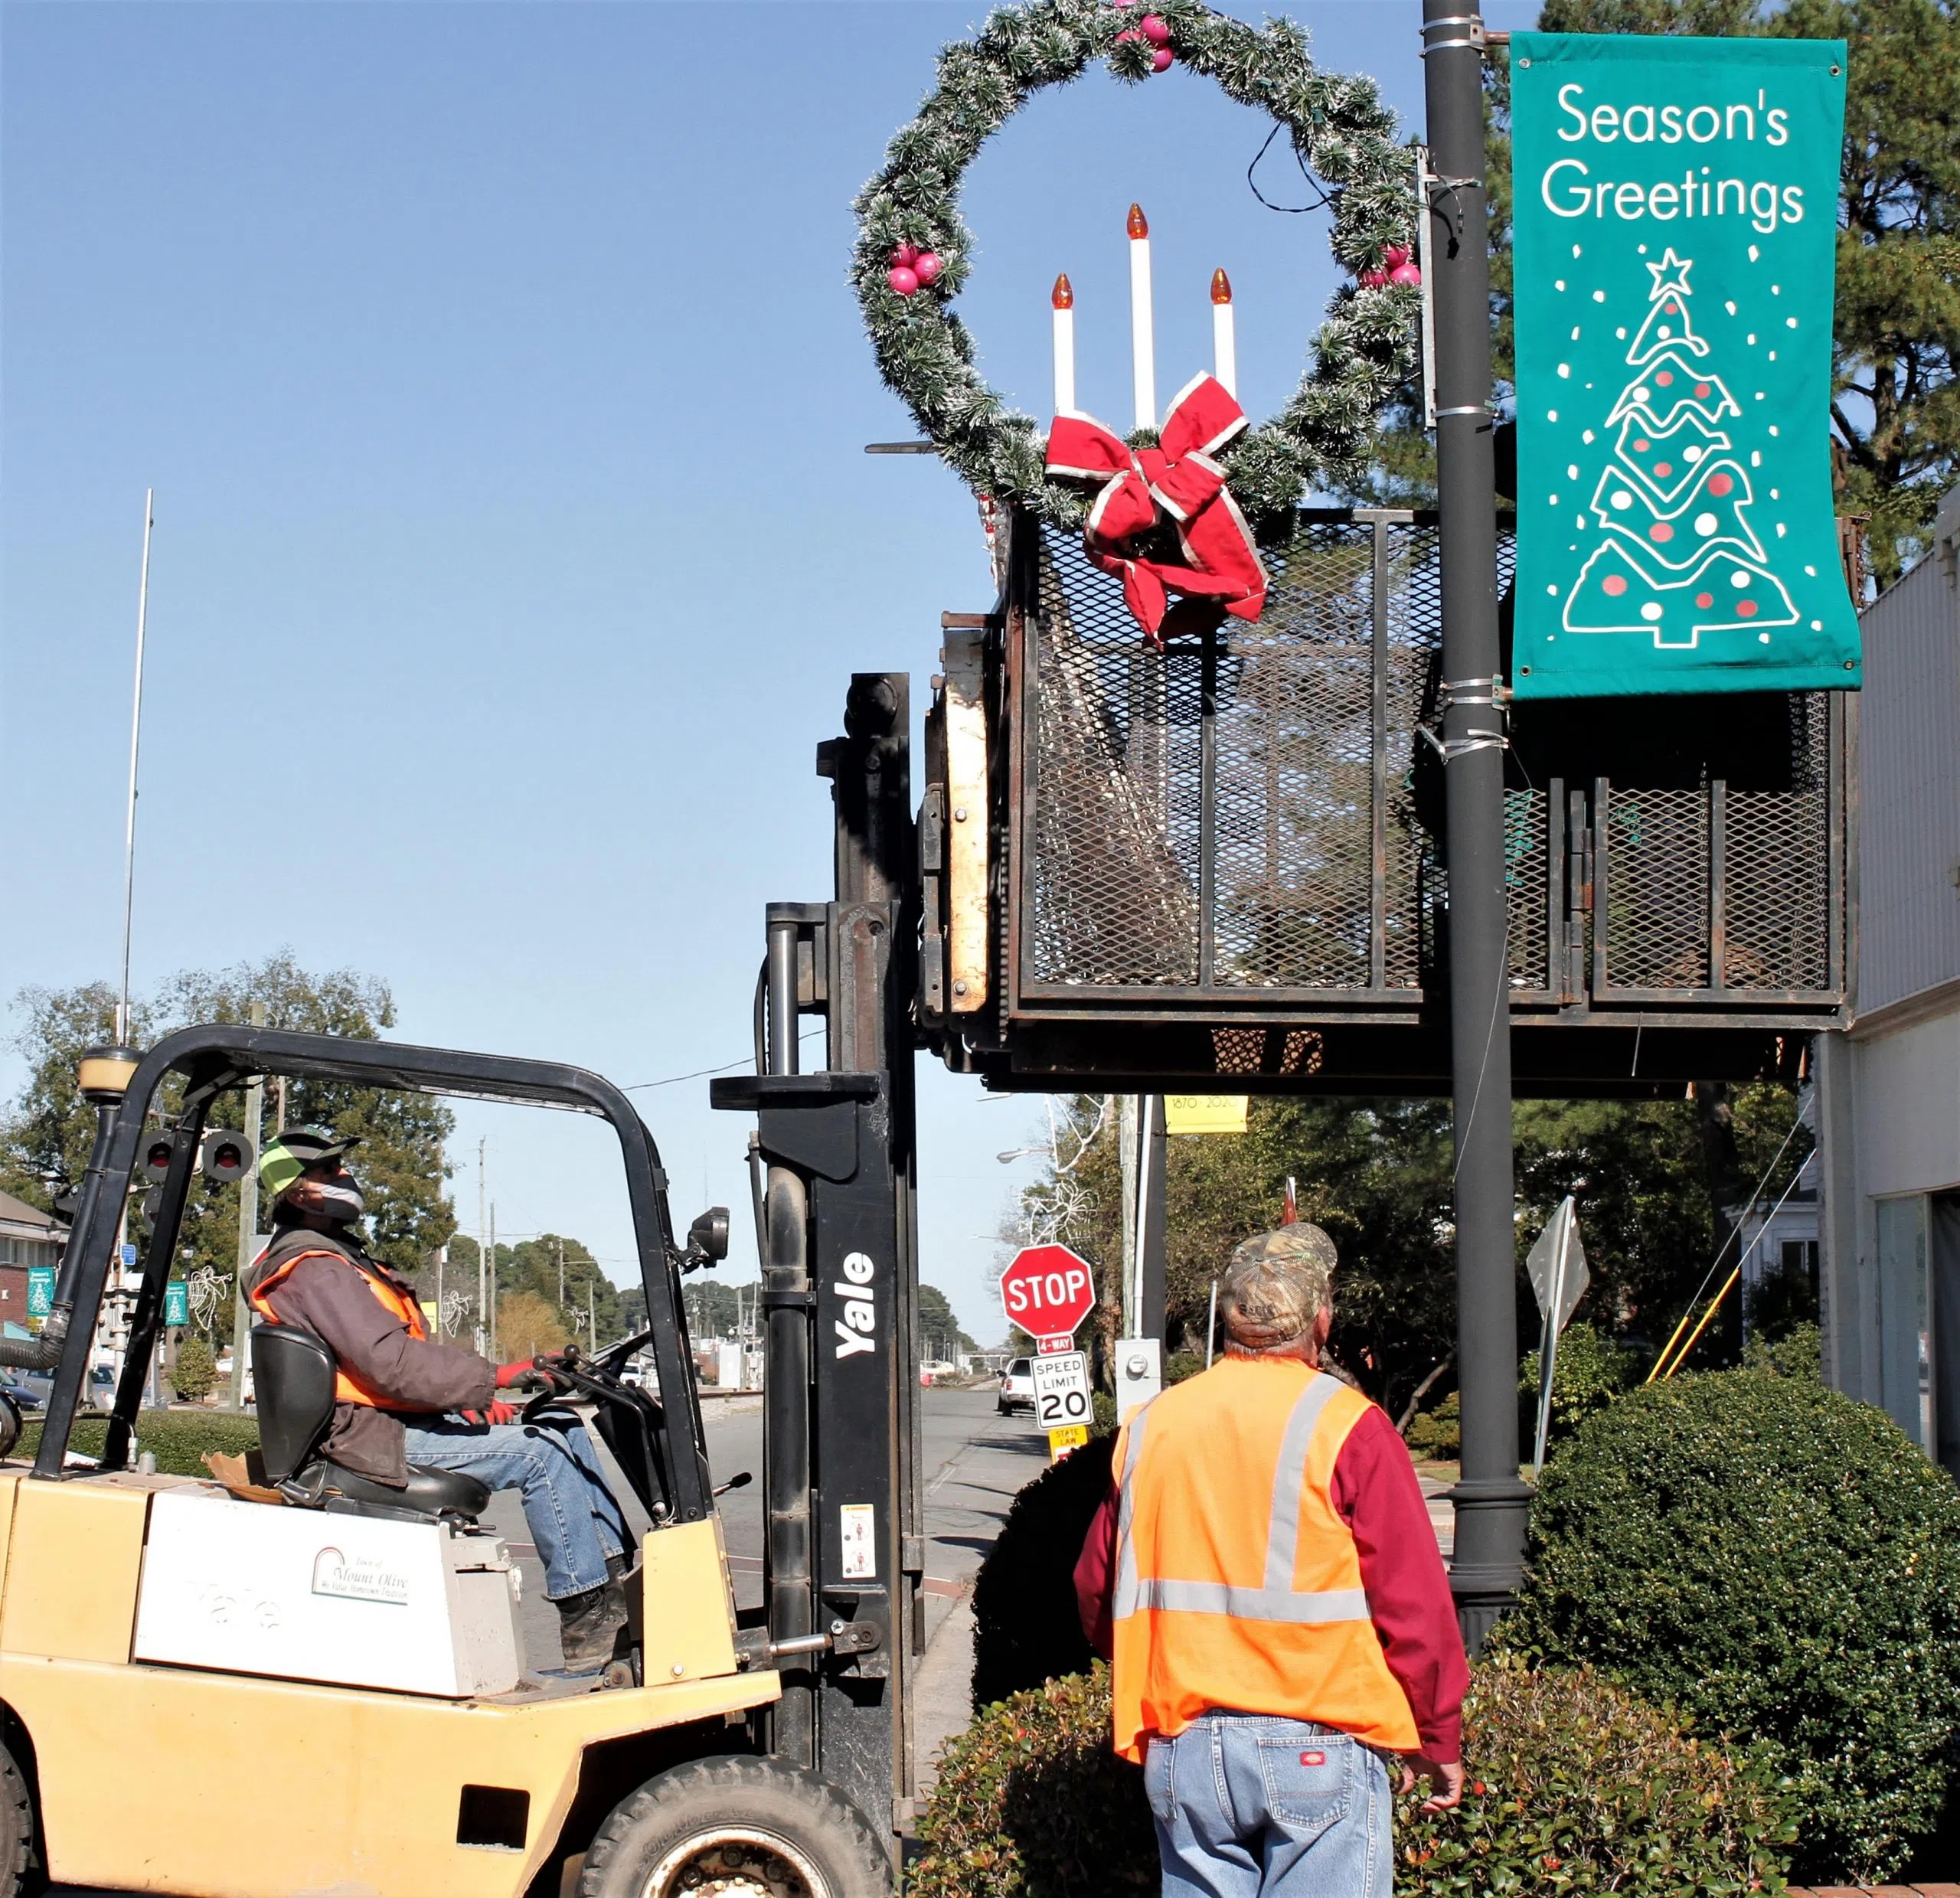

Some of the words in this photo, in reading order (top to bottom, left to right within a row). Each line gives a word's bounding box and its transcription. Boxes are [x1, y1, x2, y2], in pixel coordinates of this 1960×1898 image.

[1557, 83, 1788, 146] Season's
[1541, 158, 1805, 234] Greetings
[1172, 1097, 1197, 1109] 1870
[1207, 1096, 1238, 1108] 2020
[1008, 1269, 1086, 1312] STOP
[834, 1251, 875, 1360] Yale
[1040, 1338, 1070, 1351] 4-WAY
[1037, 1361, 1081, 1375] SPEED
[1043, 1376, 1077, 1390] LIMIT
[1041, 1391, 1086, 1420] 20
[1055, 1428, 1080, 1438] STATE
[1060, 1437, 1076, 1446] LAW
[356, 1556, 373, 1566] Town
[374, 1560, 383, 1569] of
[334, 1567, 374, 1584] Mount
[378, 1572, 408, 1589] Olive
